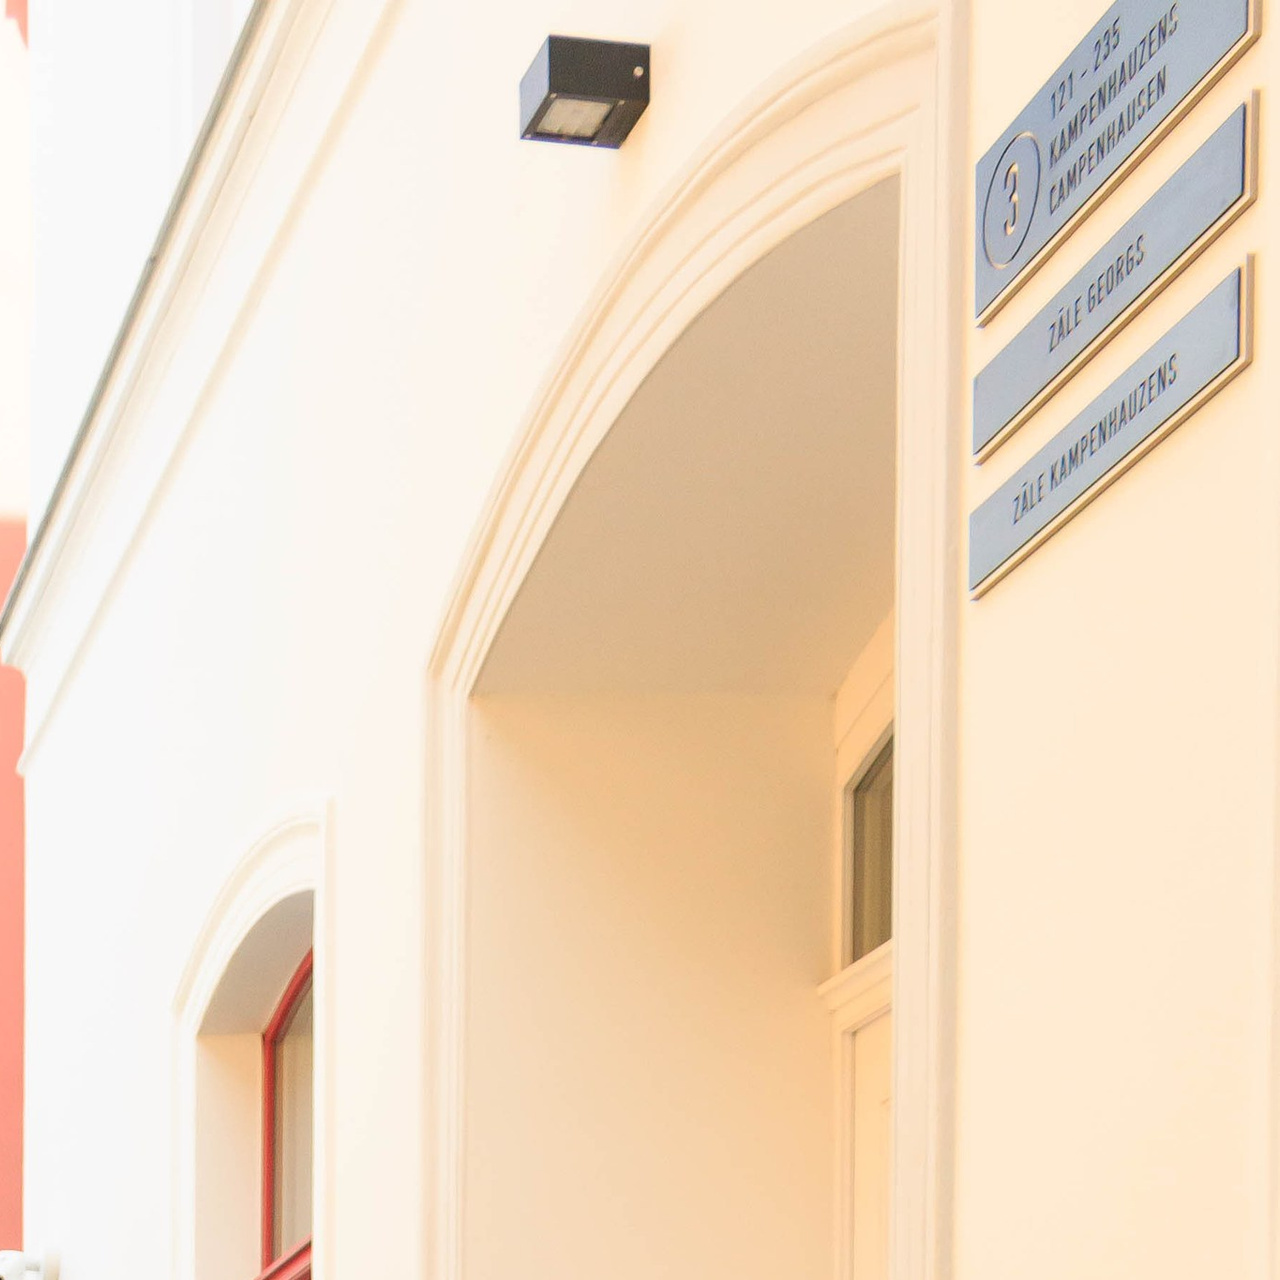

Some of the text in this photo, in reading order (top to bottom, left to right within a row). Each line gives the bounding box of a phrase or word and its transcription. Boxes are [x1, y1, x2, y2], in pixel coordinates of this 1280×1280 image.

[1049, 3, 1179, 169] KAMPENHAUZENS
[1050, 69, 1074, 120] 121
[1093, 16, 1121, 73] 235
[1003, 161, 1018, 237] 3
[1049, 64, 1168, 217] CAMPENHAUSEN
[1048, 233, 1146, 353] ZĀLE GEORGS
[1012, 352, 1179, 525] ZĀLE KAMPENHAUZENS
